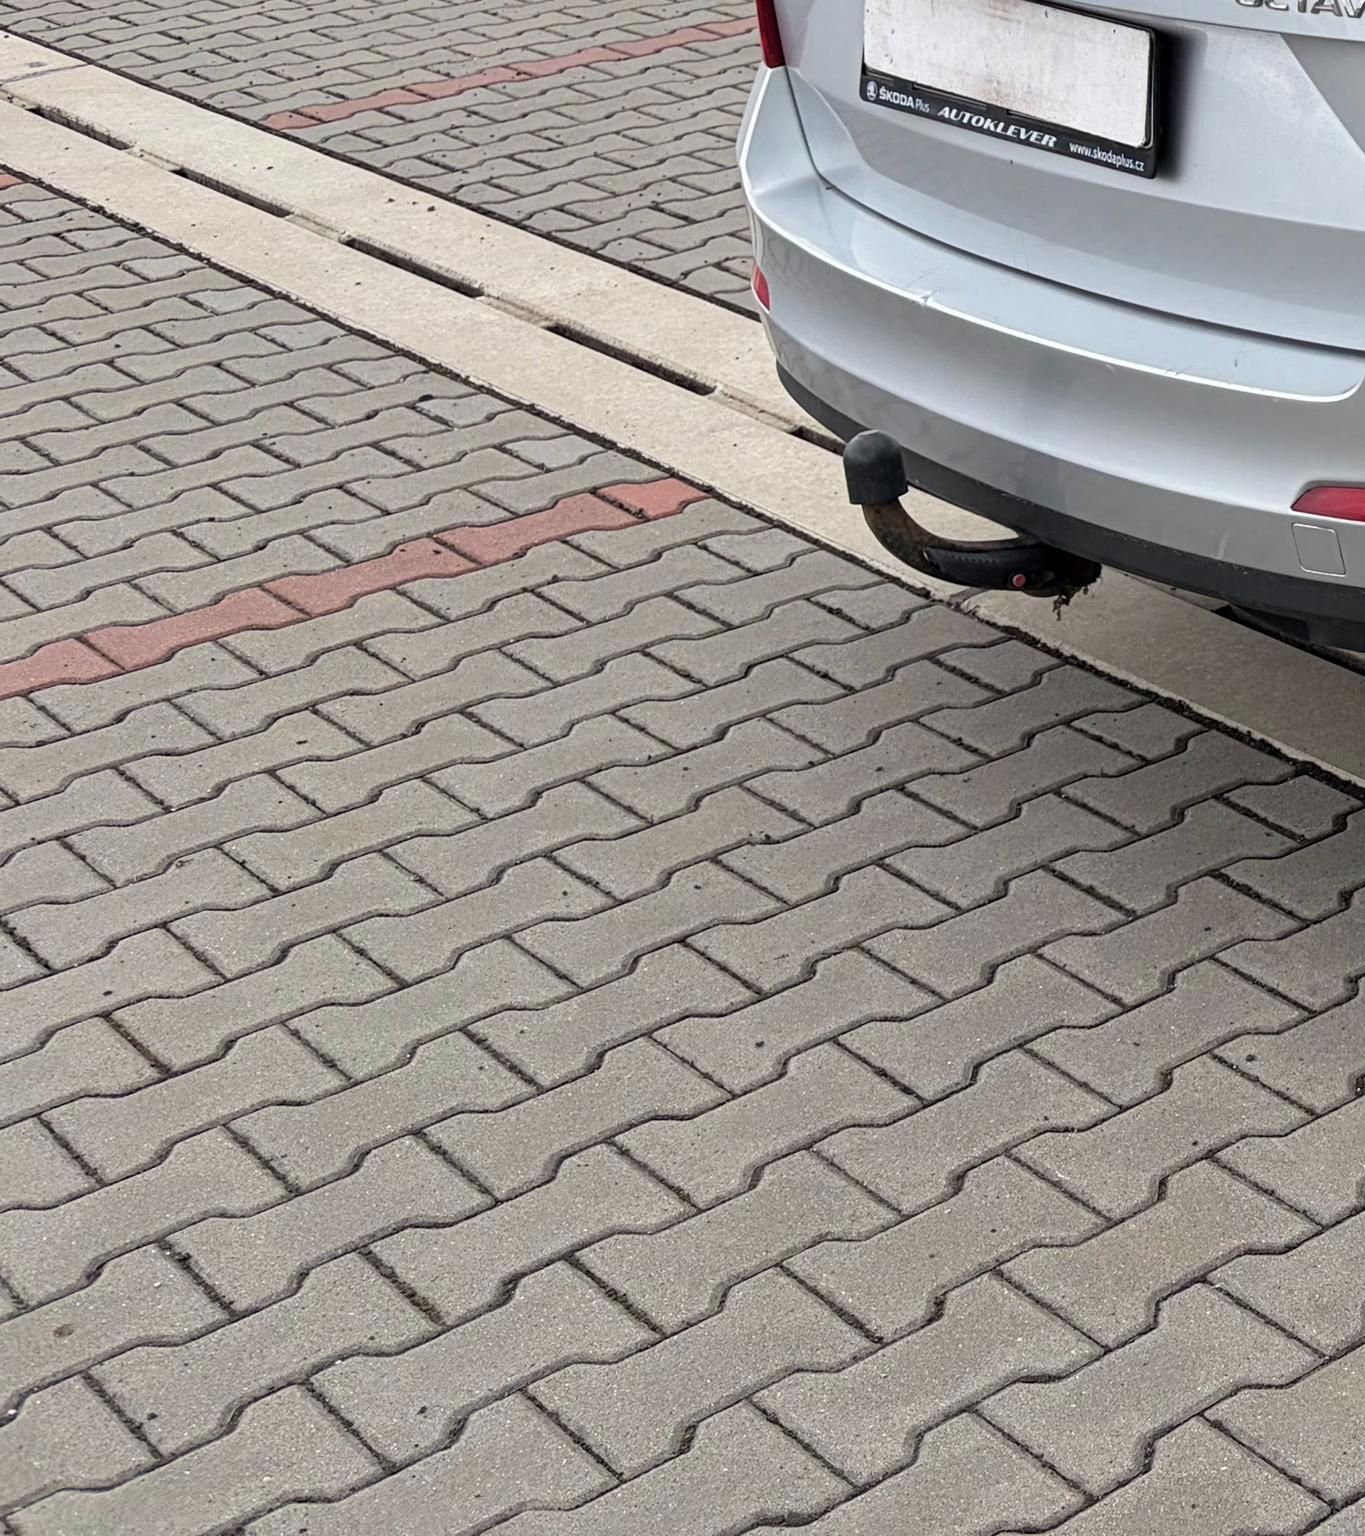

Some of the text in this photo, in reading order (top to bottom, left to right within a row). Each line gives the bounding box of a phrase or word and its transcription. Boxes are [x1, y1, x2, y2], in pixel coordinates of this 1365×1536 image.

[878, 85, 1145, 172] ŠKODA Plus AUTOKLEVER www.skodaplus.cz
